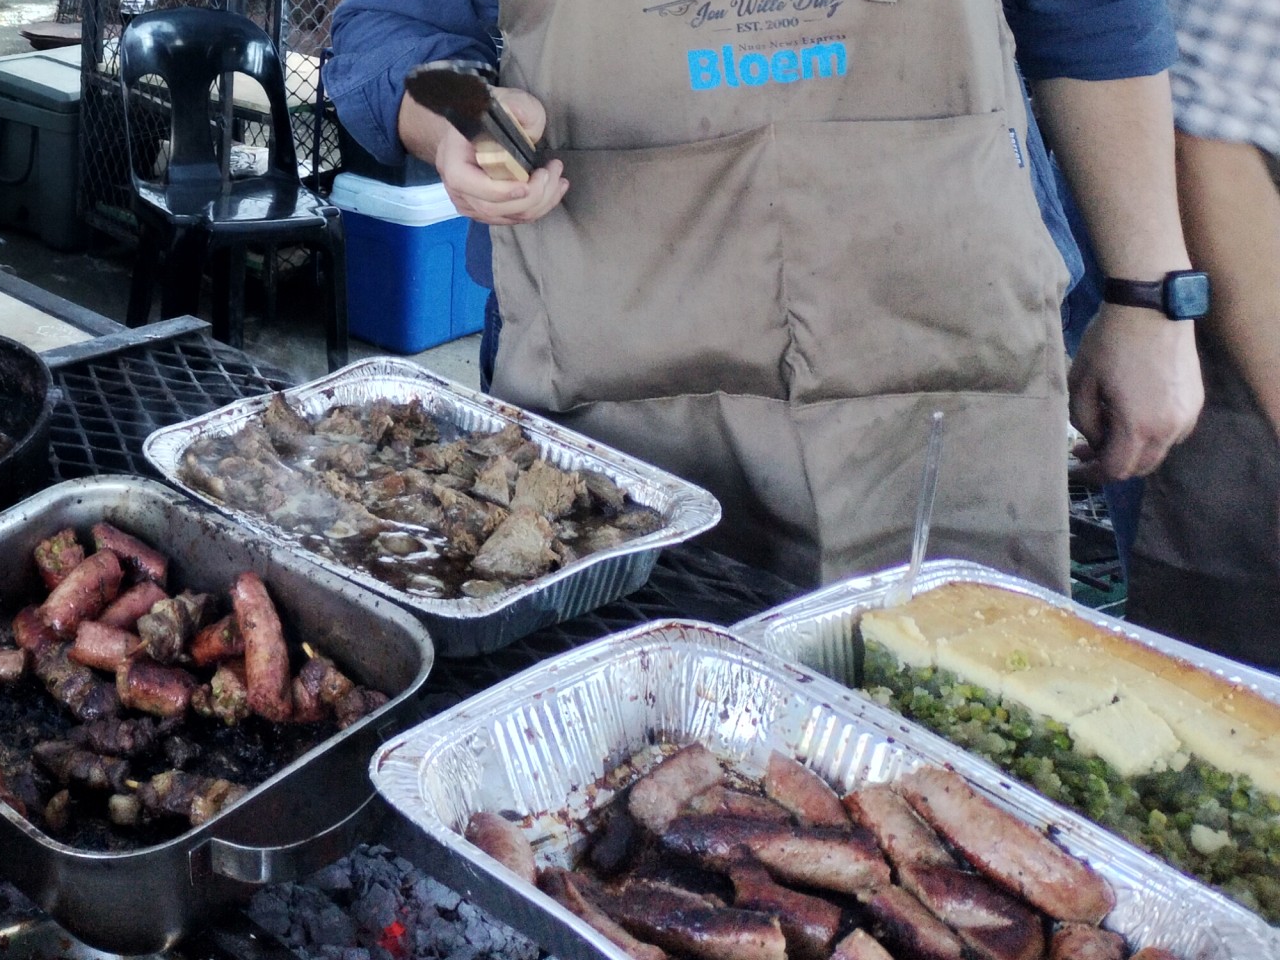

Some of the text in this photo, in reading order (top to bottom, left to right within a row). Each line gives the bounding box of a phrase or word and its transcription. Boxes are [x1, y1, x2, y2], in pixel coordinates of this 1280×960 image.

[737, 17, 799, 33] EST. 2000
[687, 41, 848, 91] Bloem
